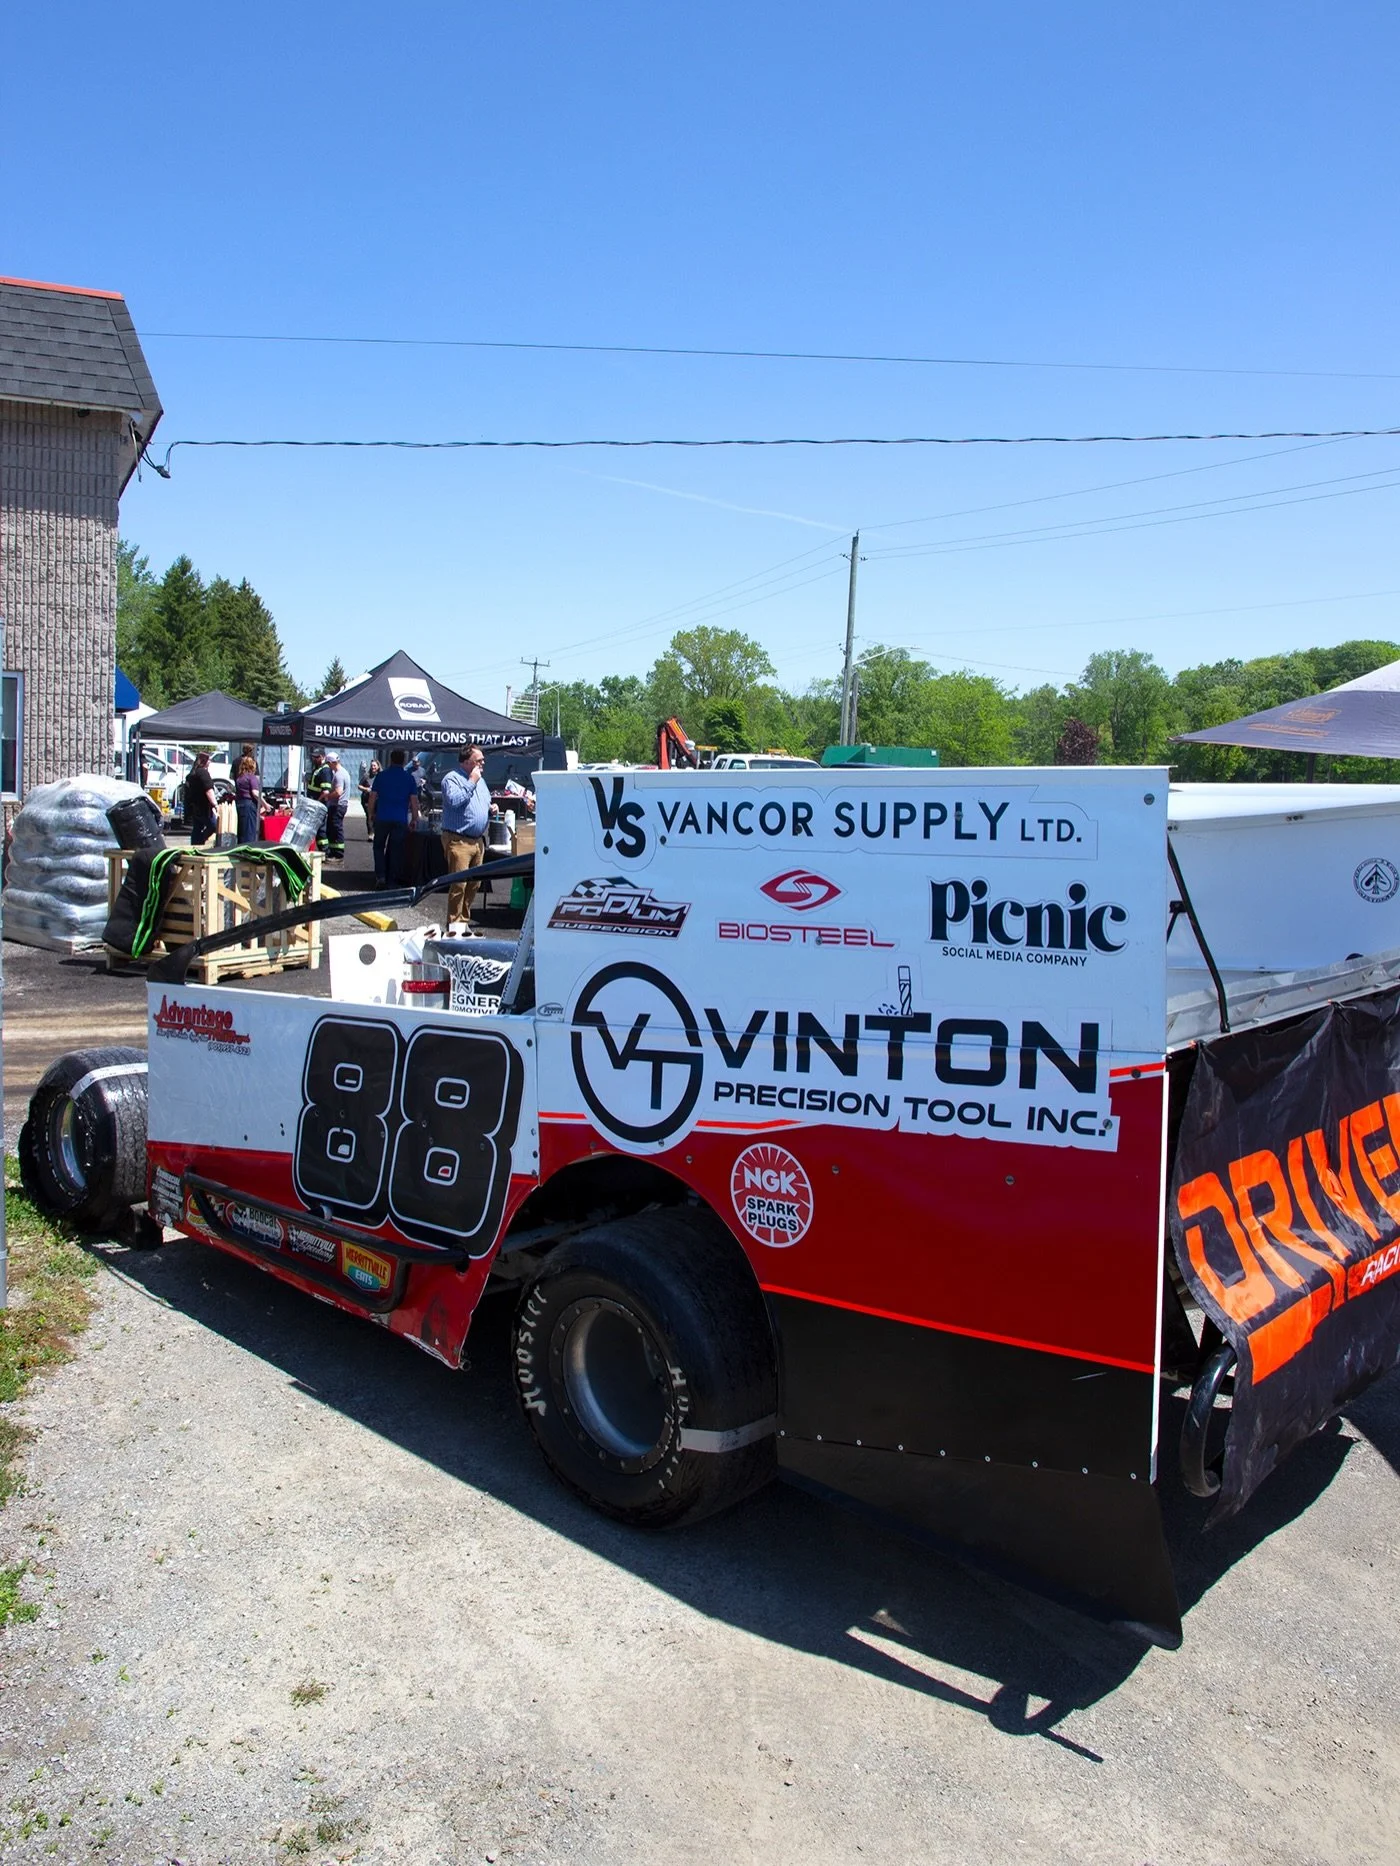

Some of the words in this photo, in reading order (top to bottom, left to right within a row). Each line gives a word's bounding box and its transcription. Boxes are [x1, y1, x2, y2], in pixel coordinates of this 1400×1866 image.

[399, 701, 432, 711] ROBAR
[314, 724, 376, 739] BUILDING
[378, 728, 467, 744] CONNECTIONS
[468, 732, 500, 746] THAT
[501, 735, 532, 747] LAST
[657, 801, 814, 838] VANCOR
[833, 802, 1010, 842] SUPPLY
[1020, 817, 1083, 843] LTD.
[559, 894, 680, 923] PODIUM
[929, 879, 1128, 953] Picnic
[552, 921, 676, 937] SUSPENSION
[718, 921, 896, 948] BIOSTEEL
[941, 946, 983, 960] SOCIAL
[985, 949, 1024, 963] MEDIA
[1026, 952, 1088, 967] COMPANY
[153, 994, 234, 1030] Advantage
[703, 1007, 1100, 1095] VINTON
[713, 1080, 890, 1118] PRECISION
[903, 1096, 1012, 1129] TOOL
[1026, 1106, 1107, 1137] INC.
[293, 1013, 524, 1258] 88
[743, 1165, 798, 1197] NGK
[747, 1197, 797, 1217] SPARK
[748, 1212, 798, 1232] PLUGS
